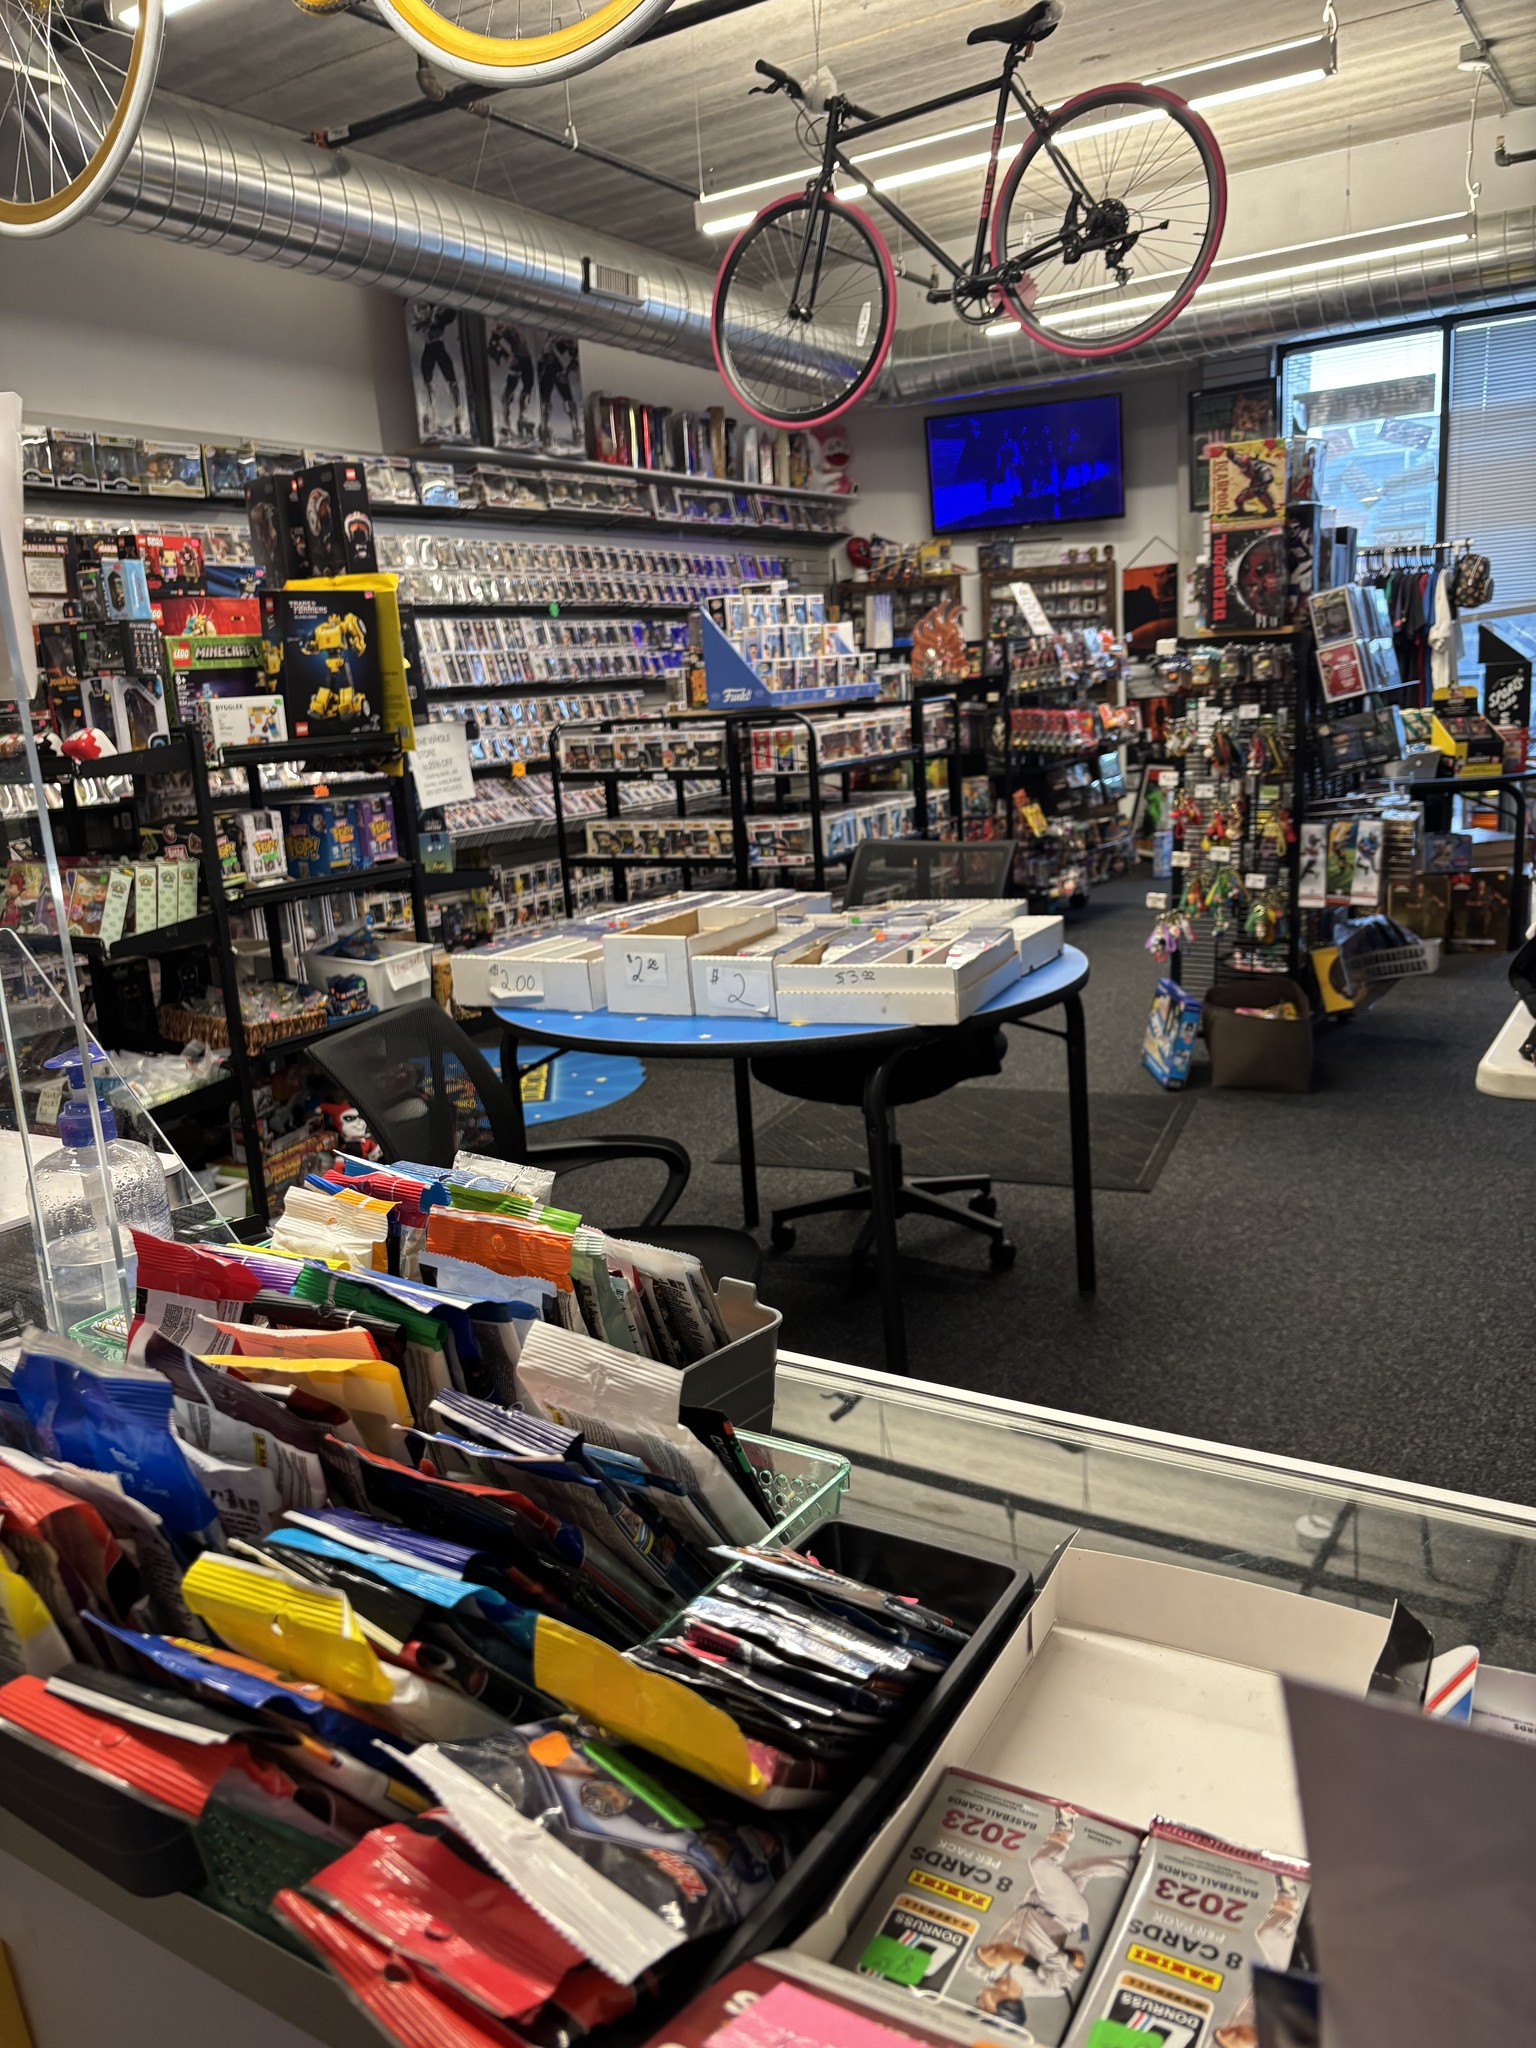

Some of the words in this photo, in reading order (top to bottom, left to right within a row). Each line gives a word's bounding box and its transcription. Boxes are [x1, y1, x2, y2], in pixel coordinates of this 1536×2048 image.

[1213, 534, 1227, 621] DEADPOOL
[173, 648, 189, 659] LEGO
[195, 644, 259, 658] MINECRAFT
[722, 687, 752, 703] Funko
[947, 1795, 984, 1815] CARDS
[942, 1808, 1027, 1851] 2023
[985, 1806, 1038, 1831] BASEBALL
[936, 1838, 971, 1862] PACK
[975, 1852, 1003, 1870] PER
[909, 1846, 993, 1886] CARDS
[1157, 1862, 1200, 1884] CARDS
[911, 1871, 990, 1908] PANINI
[995, 1876, 1014, 1894] 8
[1201, 1877, 1259, 1899] BASEBALL
[1154, 1877, 1249, 1924] 2023
[893, 1910, 965, 1947] DONRUSS
[1128, 1919, 1221, 1962] CARDS
[1199, 1926, 1227, 1945] PER
[1132, 1949, 1217, 1985] PANINI
[1225, 1953, 1243, 1971] 8
[1119, 1990, 1200, 2031] DONRUSS
